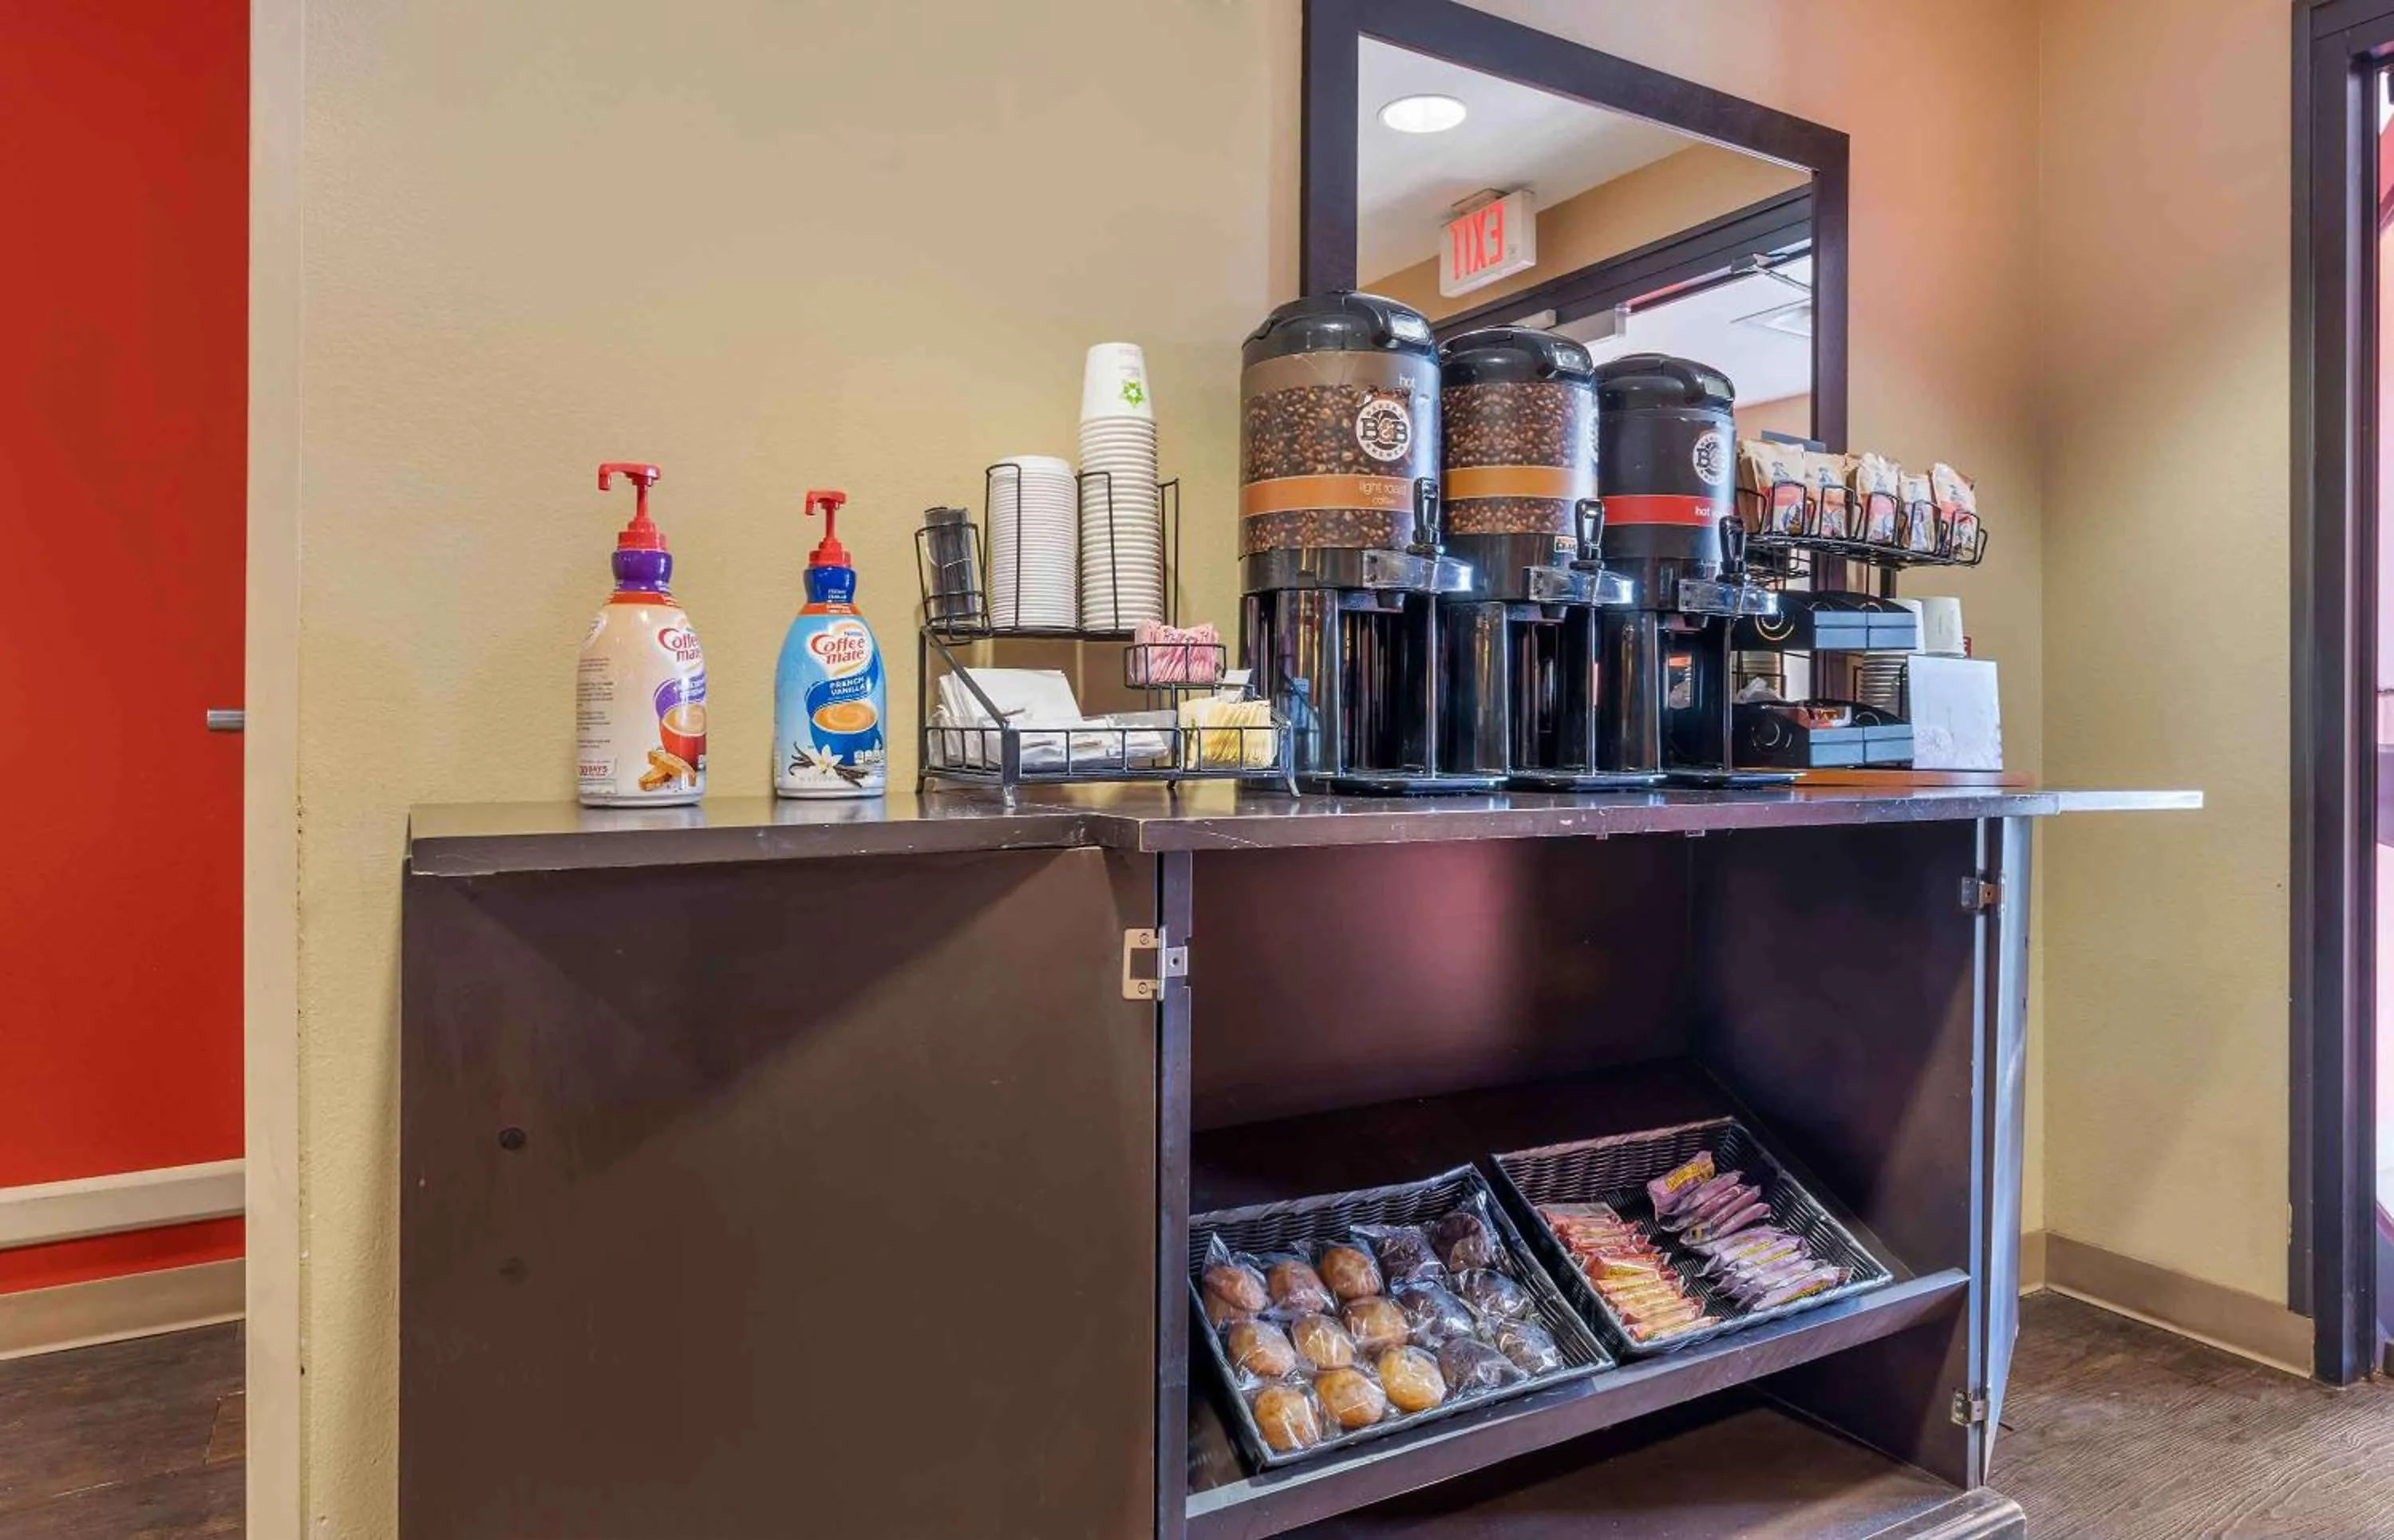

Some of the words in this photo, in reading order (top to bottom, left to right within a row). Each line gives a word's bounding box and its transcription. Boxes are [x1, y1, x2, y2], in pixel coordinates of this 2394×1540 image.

[811, 634, 865, 655] Coffee
[826, 650, 864, 665] mate
[830, 676, 864, 689] FRENCH
[831, 684, 866, 697] VANILLA
